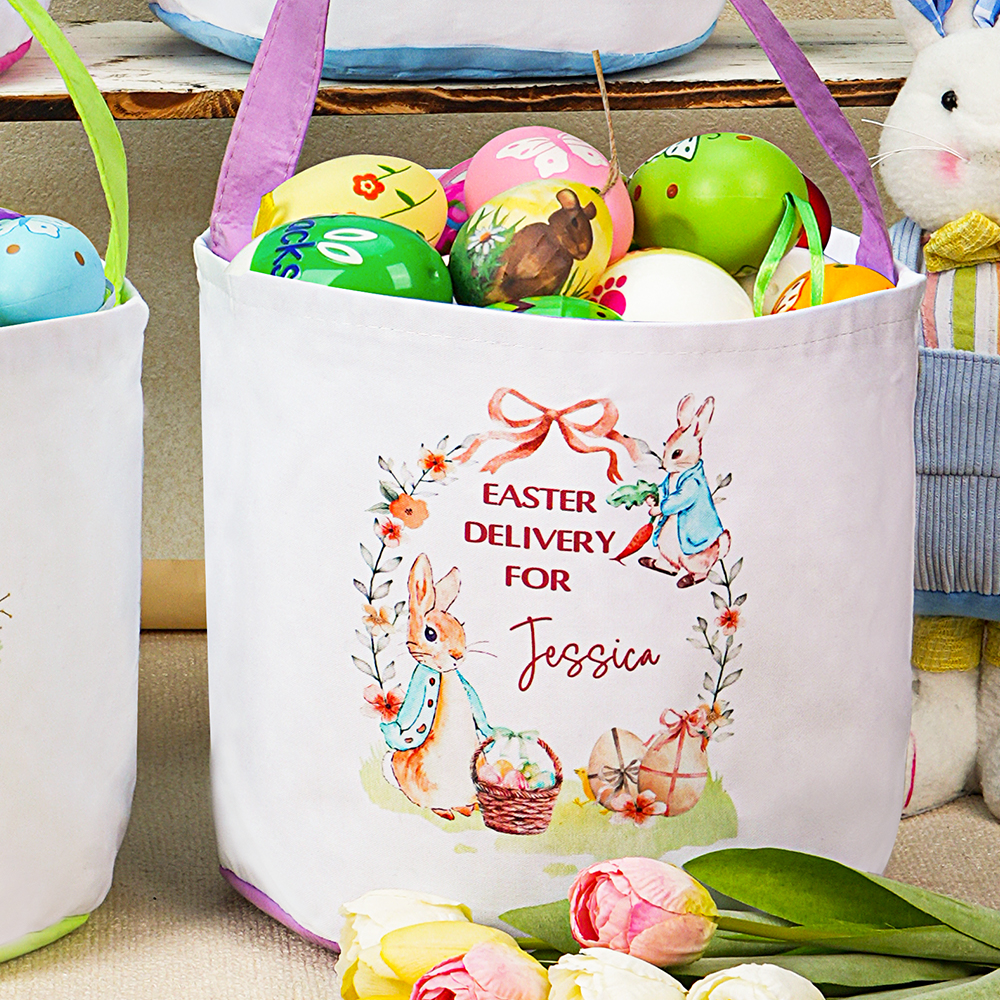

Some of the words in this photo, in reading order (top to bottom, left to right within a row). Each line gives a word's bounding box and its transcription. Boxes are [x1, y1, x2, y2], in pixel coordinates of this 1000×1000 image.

[482, 482, 598, 514] EASTER
[463, 521, 616, 554] DELIVERY
[504, 564, 572, 593] FOR
[509, 615, 661, 693] Jessica
